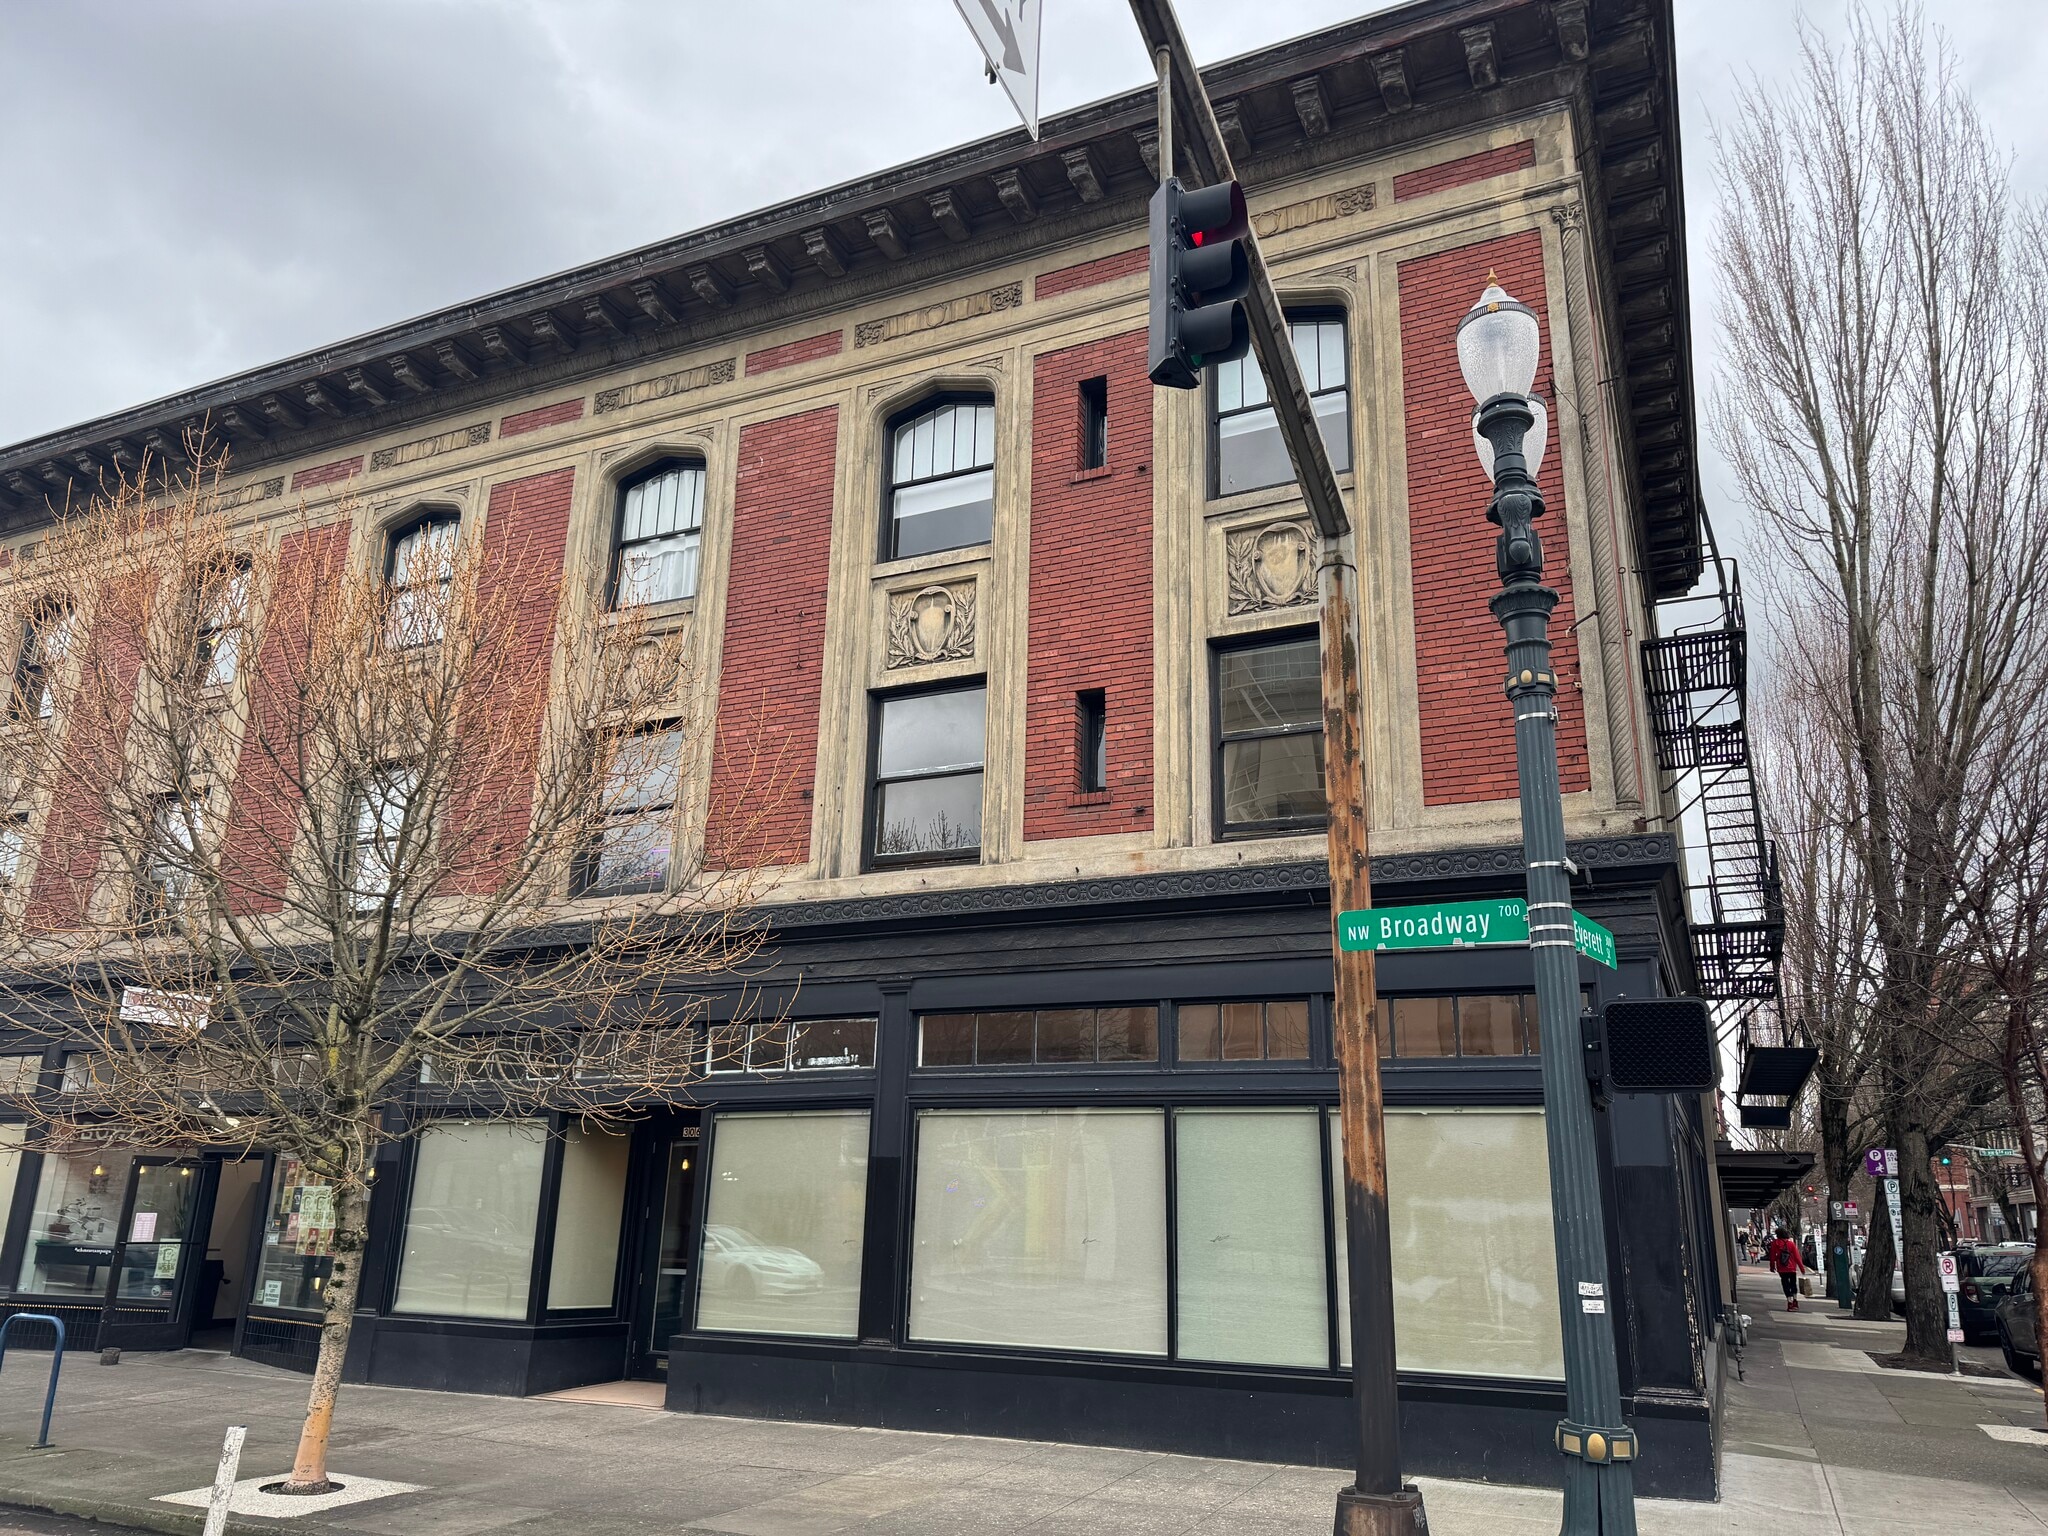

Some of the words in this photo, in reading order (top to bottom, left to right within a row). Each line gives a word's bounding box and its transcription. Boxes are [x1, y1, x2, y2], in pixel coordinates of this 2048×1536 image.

[1348, 925, 1370, 941] NW
[1380, 911, 1490, 939] Broadway
[1498, 904, 1520, 918] 700
[1573, 919, 1604, 956] Everett
